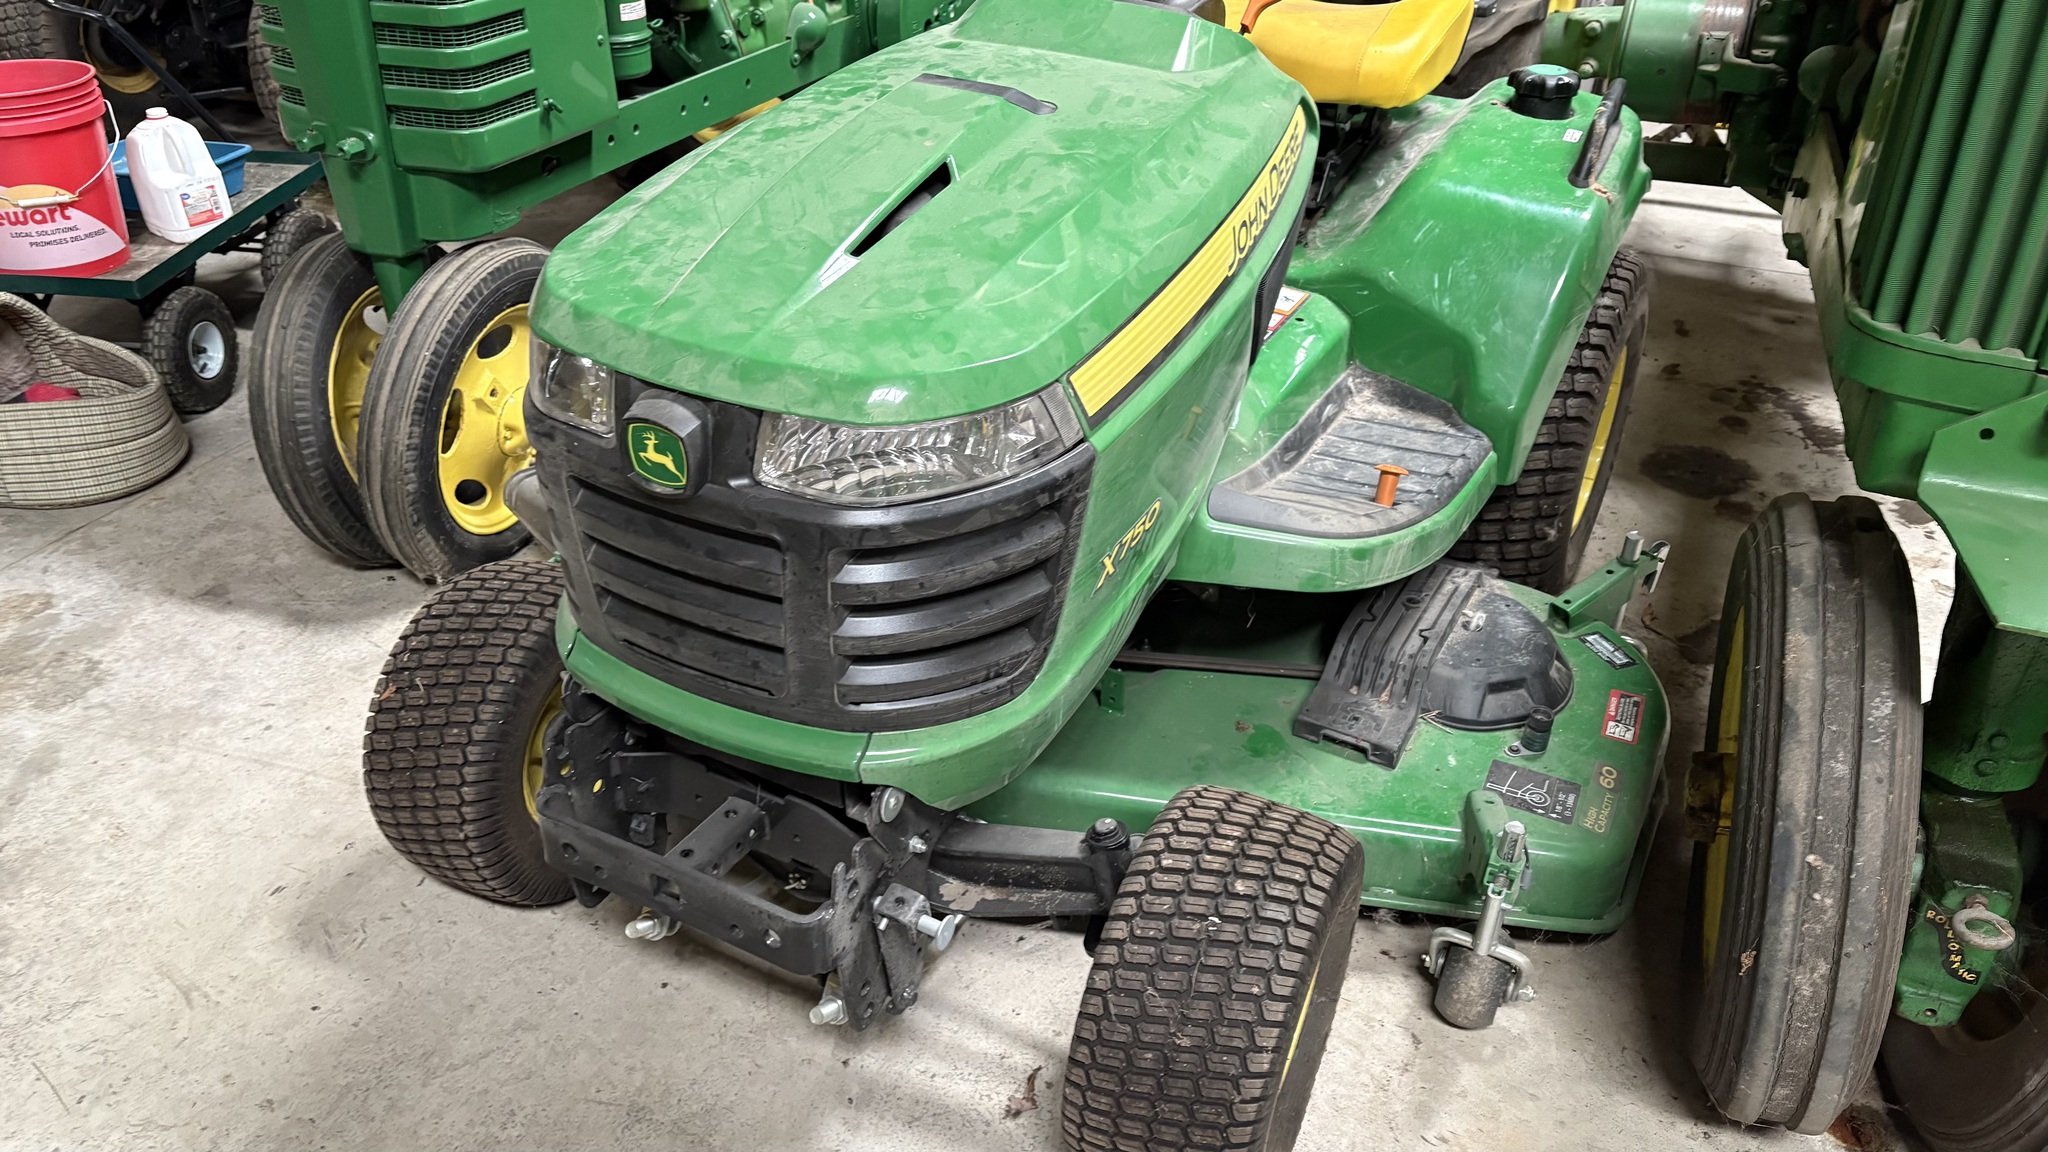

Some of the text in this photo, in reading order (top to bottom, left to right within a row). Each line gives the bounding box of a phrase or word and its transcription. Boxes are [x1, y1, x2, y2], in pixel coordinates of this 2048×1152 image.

[1228, 120, 1300, 273] JOHN DEERE
[10, 224, 81, 239] LOCAL SOLUTIONS.
[29, 237, 69, 248] PROMISES
[1096, 501, 1161, 589] X750
[1599, 766, 1618, 789] 60
